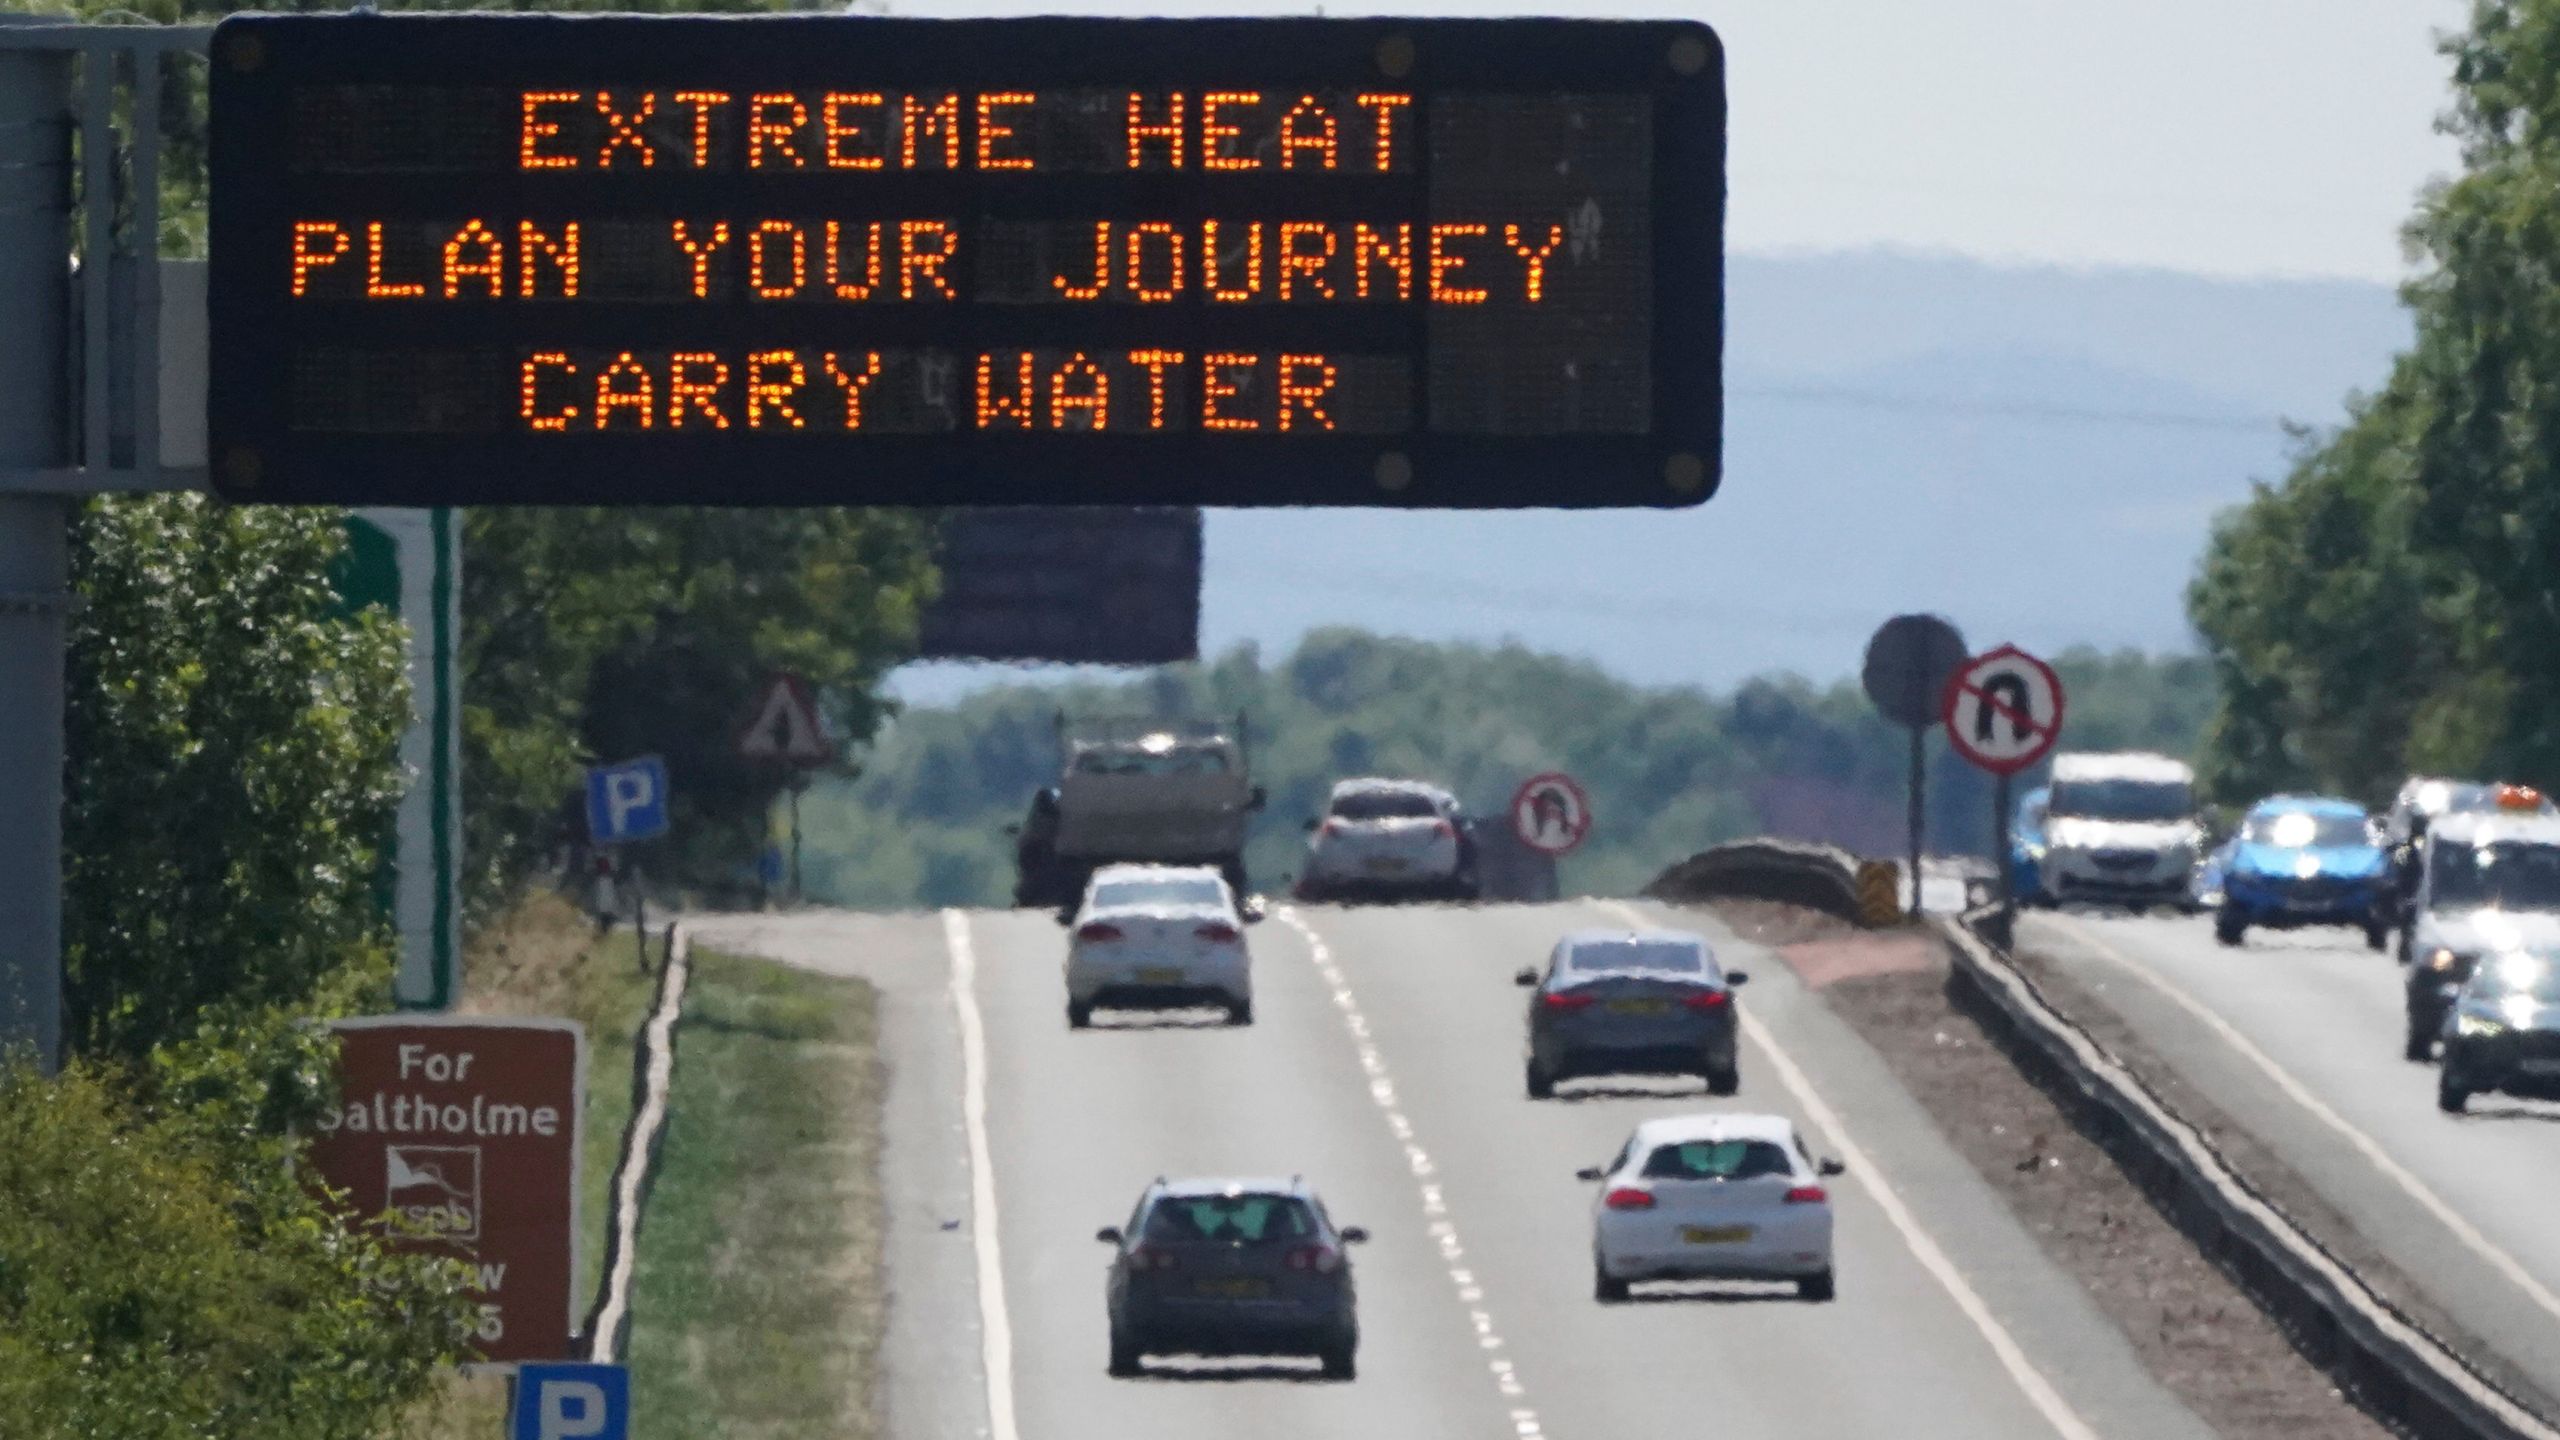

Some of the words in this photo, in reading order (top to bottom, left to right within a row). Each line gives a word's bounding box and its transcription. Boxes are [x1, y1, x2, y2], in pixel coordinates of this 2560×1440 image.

[521, 92, 1034, 169] EXTREME
[1127, 93, 1410, 170] HEAT
[292, 220, 579, 297] PLAN
[672, 221, 957, 300] YOUR
[1053, 220, 1561, 303] JOURNEY
[521, 350, 880, 430] CARRY
[976, 349, 1335, 430] WATER
[605, 769, 653, 833] P
[399, 1044, 475, 1083] For
[539, 1380, 607, 1440] P
